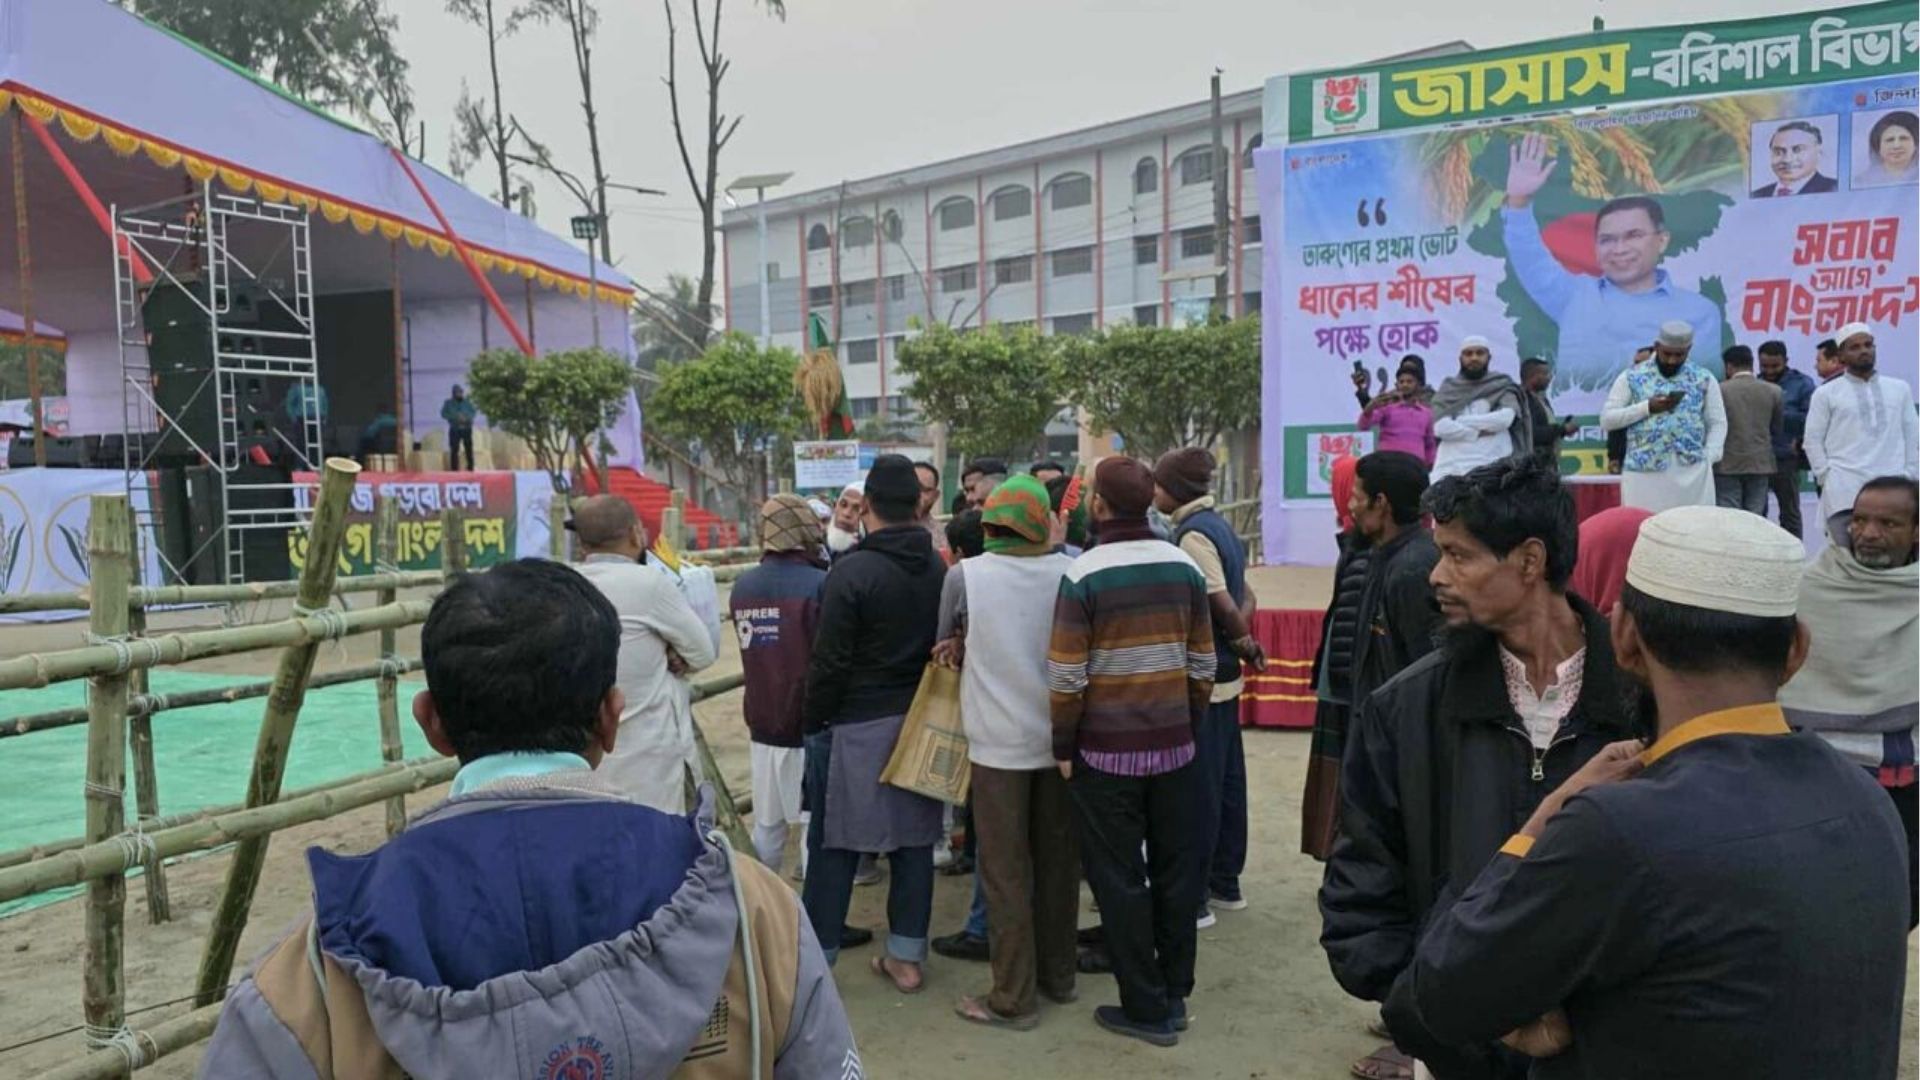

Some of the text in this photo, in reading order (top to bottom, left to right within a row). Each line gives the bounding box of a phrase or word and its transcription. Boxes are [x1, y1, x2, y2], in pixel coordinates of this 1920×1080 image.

[1392, 43, 1631, 117] জাসাস
[1302, 225, 1460, 269] তারুণ্যের প্রথম ভোট
[1793, 216, 1900, 276] সবার
[1299, 263, 1477, 319] ধানের শীষের
[1810, 266, 1872, 292] আগে
[1314, 320, 1440, 360] পক্ষে হোক
[446, 482, 483, 510] দেশ
[735, 607, 780, 620] SUPREME
